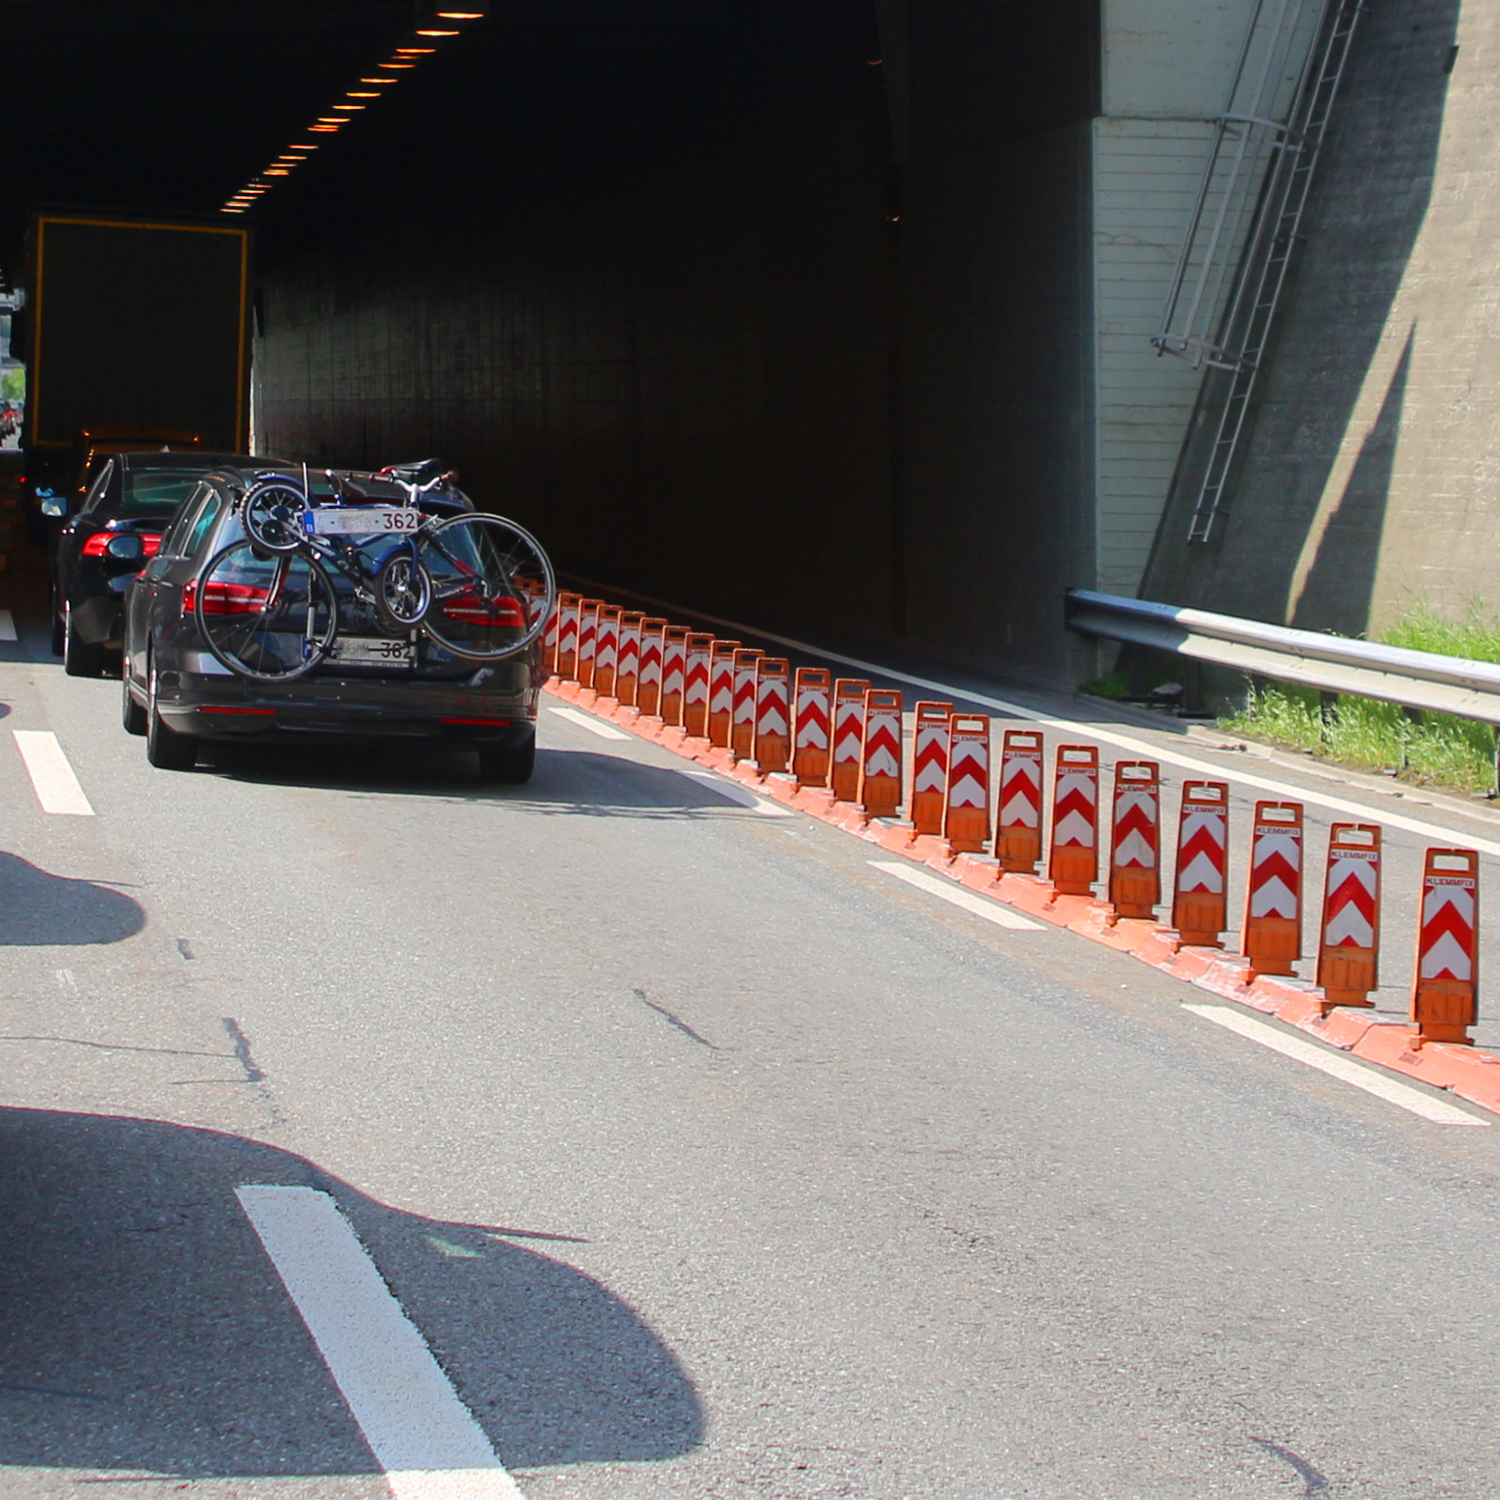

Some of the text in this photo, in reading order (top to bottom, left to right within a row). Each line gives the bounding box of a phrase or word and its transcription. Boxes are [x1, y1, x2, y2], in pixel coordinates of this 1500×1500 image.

[1004, 751, 1041, 760] KLEMMFIX
[1184, 805, 1226, 815] KLEMMFIX
[1256, 826, 1300, 836] KLEMMFIX
[1330, 850, 1378, 861] KLEMMFIX
[1425, 876, 1475, 889] KLEMMFIX
